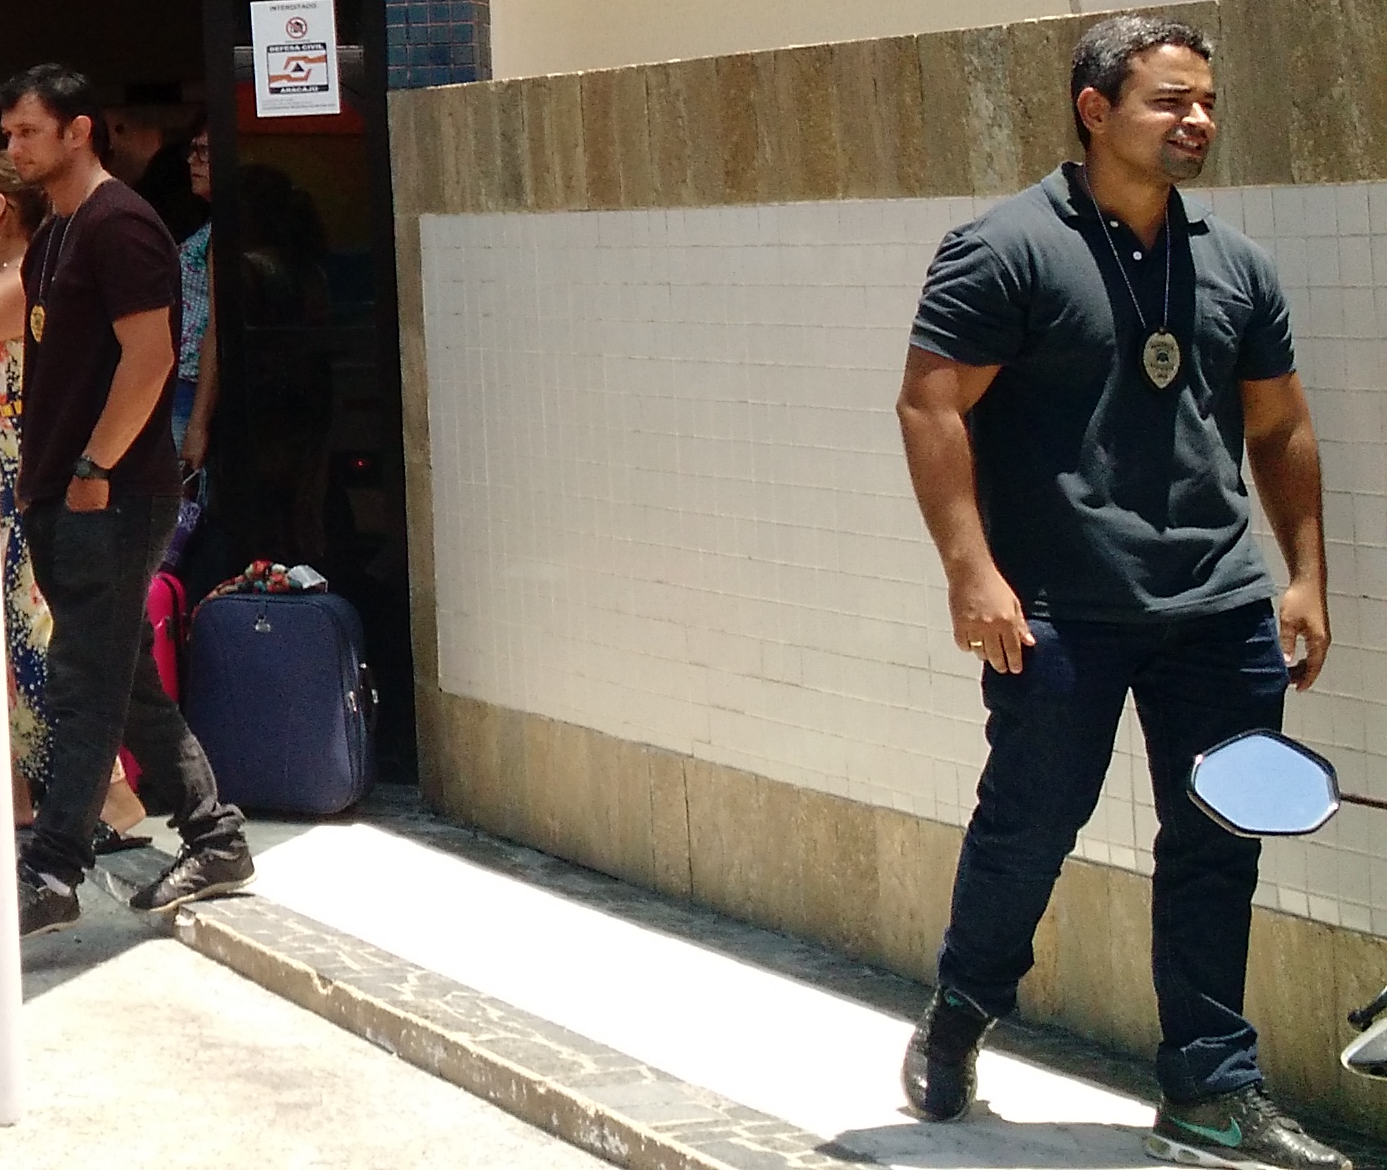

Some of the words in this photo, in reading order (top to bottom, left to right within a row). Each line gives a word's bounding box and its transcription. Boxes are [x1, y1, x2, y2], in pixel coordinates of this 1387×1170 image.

[269, 3, 317, 11] INTERDITADO
[269, 45, 300, 53] DEFESA
[301, 43, 323, 51] CIVIL
[280, 86, 318, 94] ARACAJU
